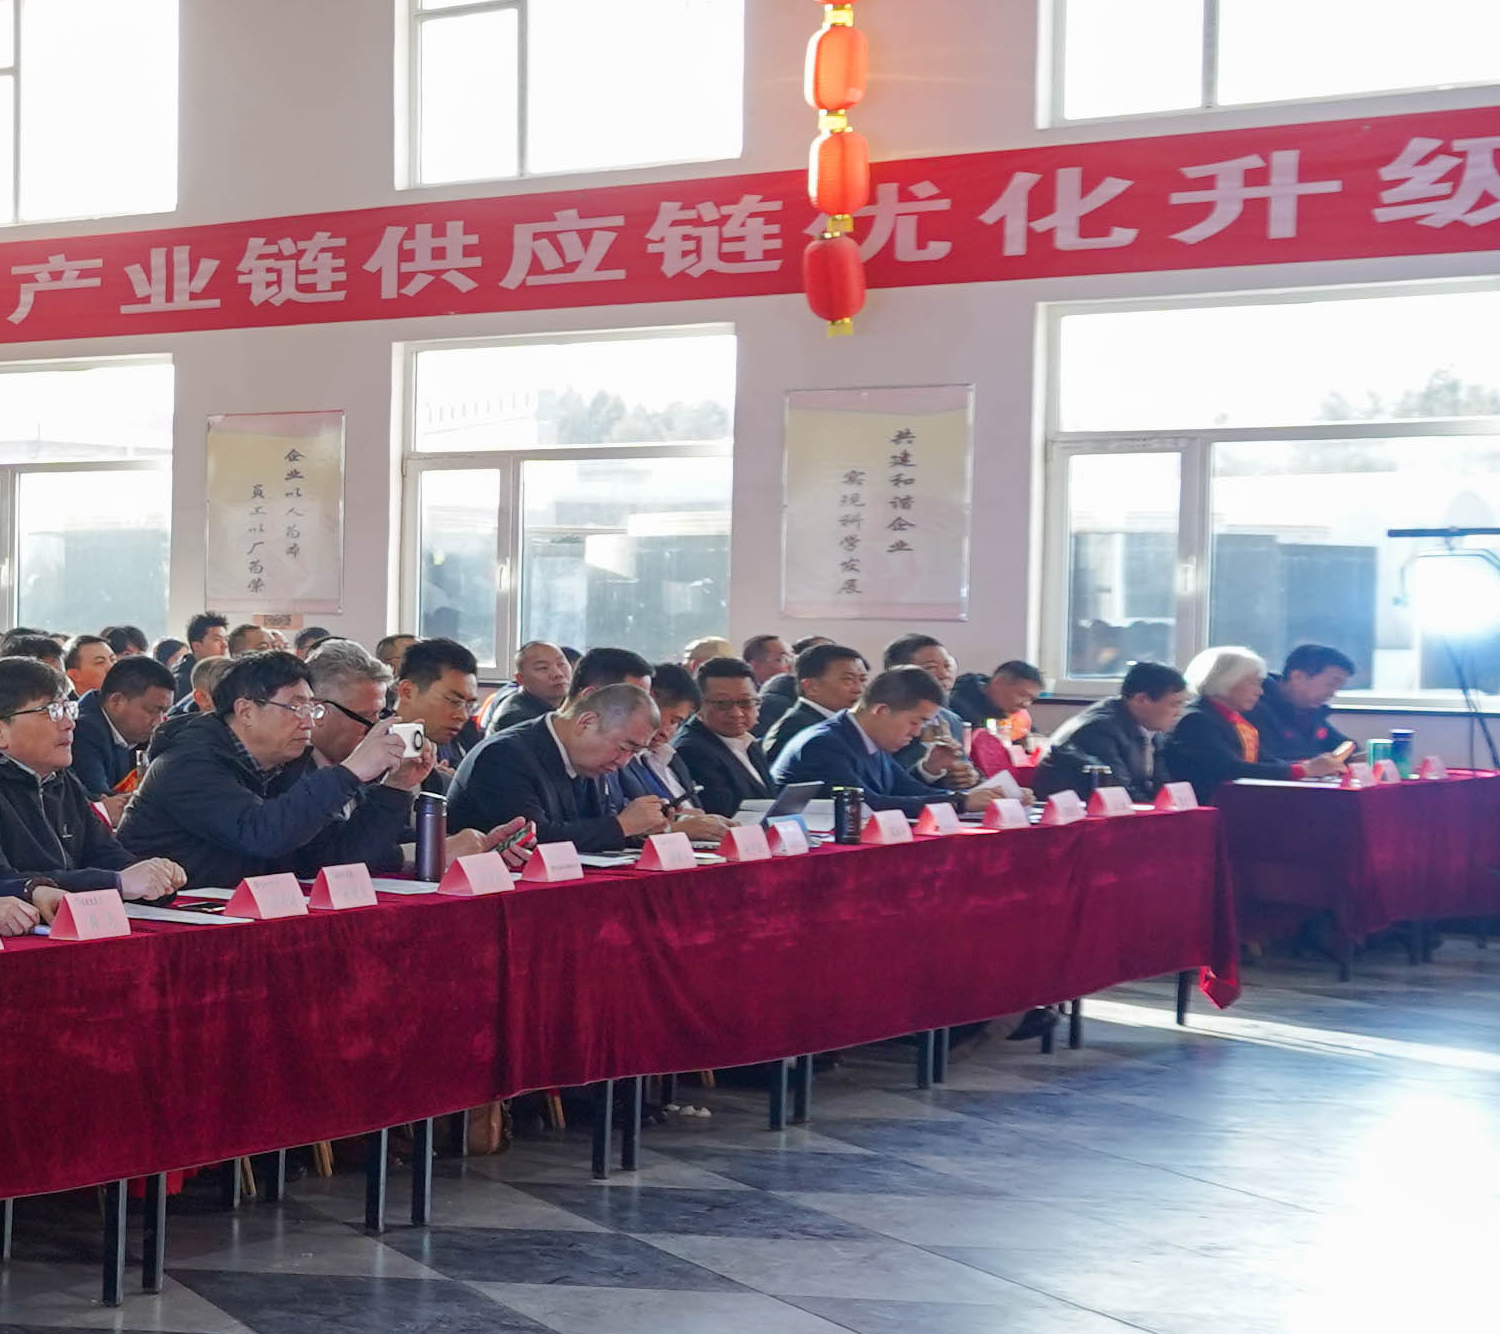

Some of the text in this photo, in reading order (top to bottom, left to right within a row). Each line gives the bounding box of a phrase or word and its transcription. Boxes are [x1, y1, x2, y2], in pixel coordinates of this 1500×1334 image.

[247, 484, 268, 593] 员工以厂为荣
[284, 449, 305, 558] 企业以人为本
[886, 428, 917, 553] 共建和谐企业
